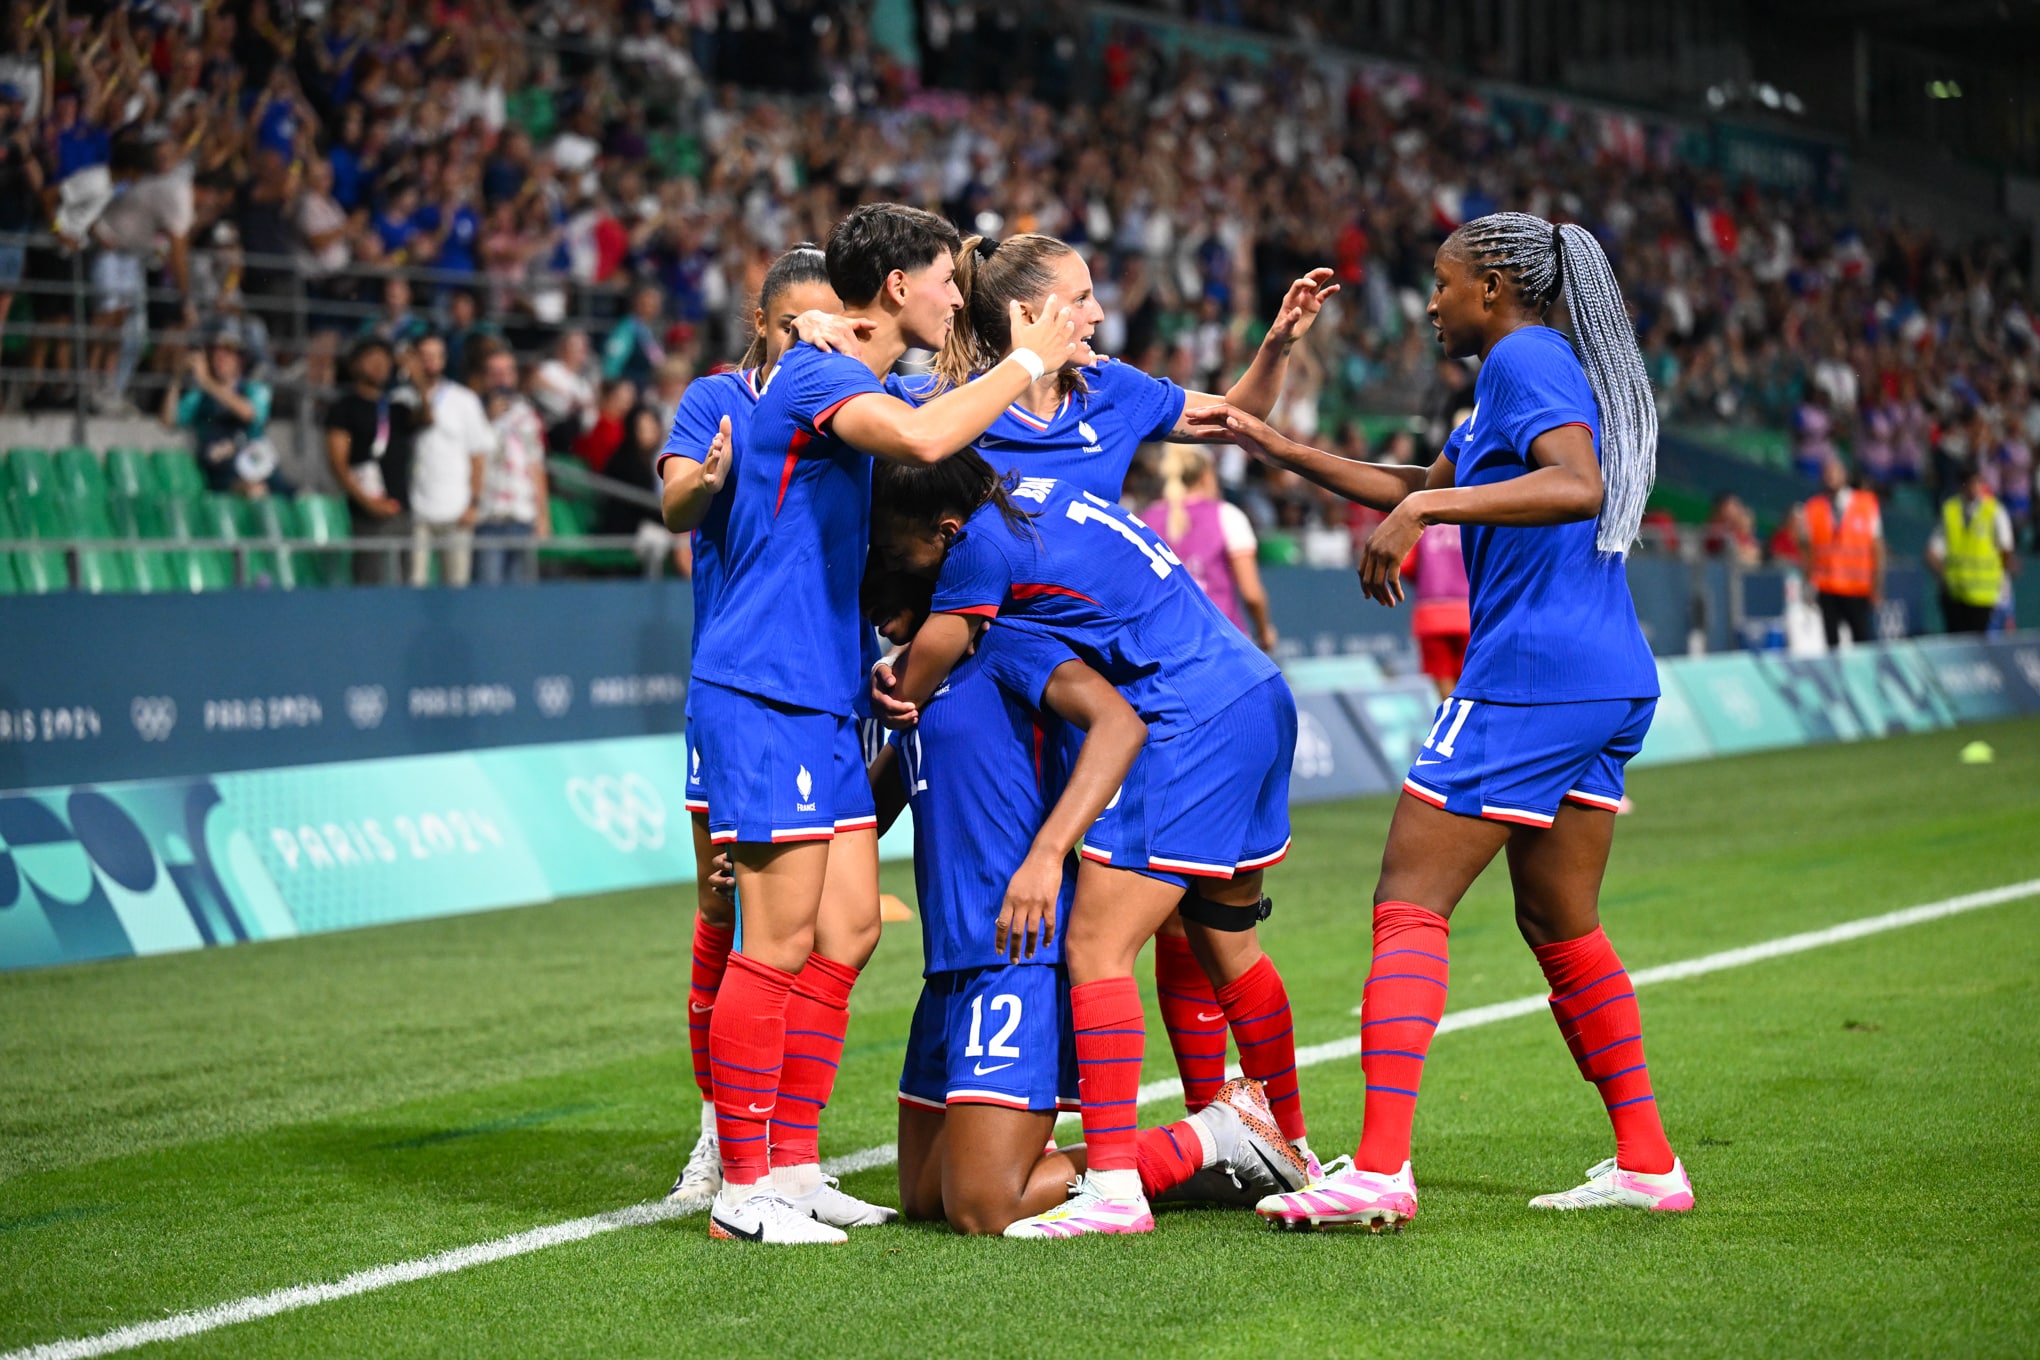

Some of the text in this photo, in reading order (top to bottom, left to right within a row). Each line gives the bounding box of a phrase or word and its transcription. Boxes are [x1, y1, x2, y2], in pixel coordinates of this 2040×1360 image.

[40, 705, 101, 741] 2024
[204, 693, 324, 731] PARIS 2024
[1423, 697, 1475, 758] 11
[272, 797, 504, 872] PARIS 2024
[964, 993, 1023, 1058] 12
